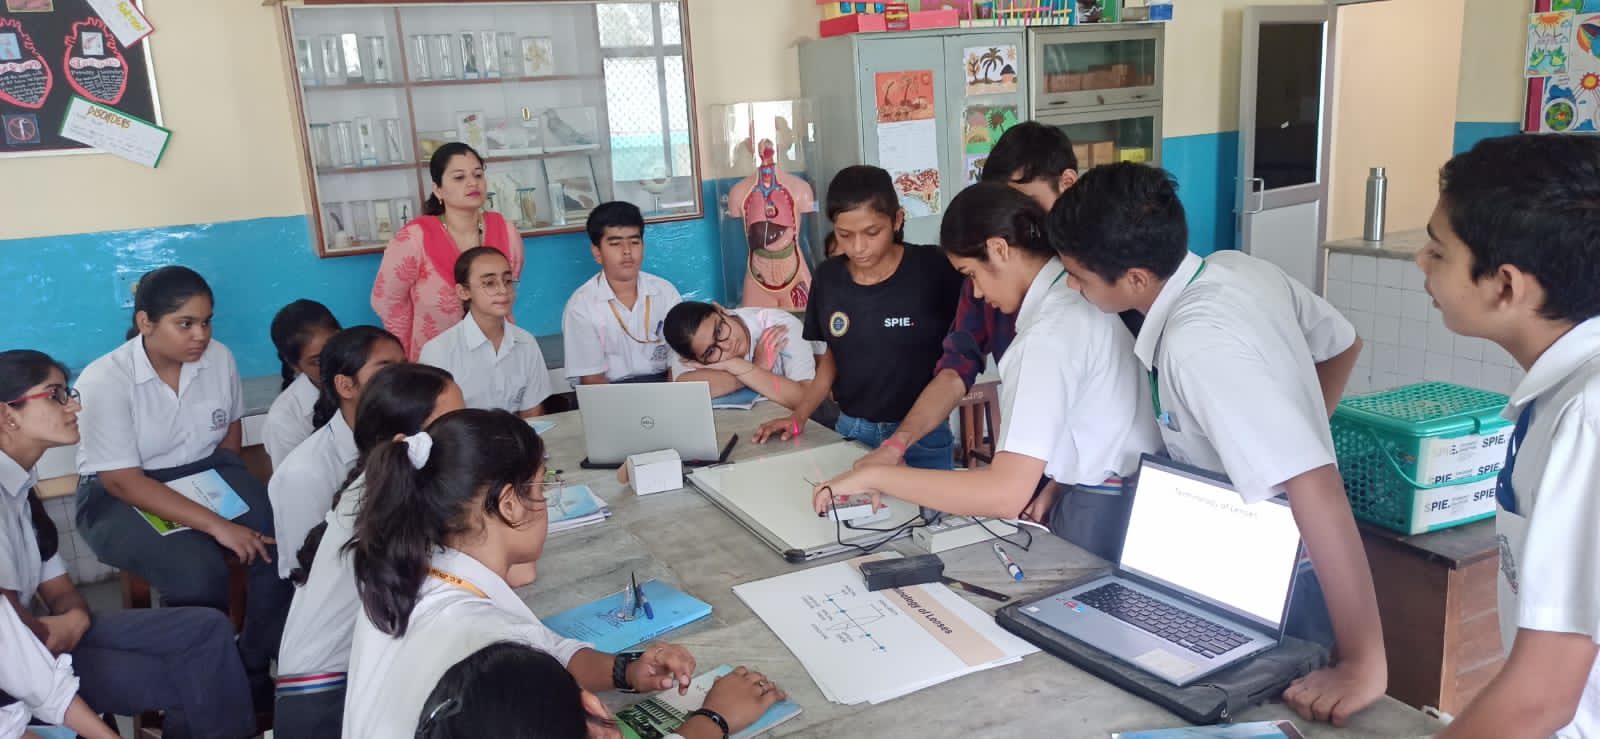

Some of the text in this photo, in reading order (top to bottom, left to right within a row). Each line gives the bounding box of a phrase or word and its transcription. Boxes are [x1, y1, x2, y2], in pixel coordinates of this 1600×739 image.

[884, 317, 915, 328] SPIE.
[1482, 434, 1506, 448] SPIE.
[925, 613, 953, 634] Lenses
